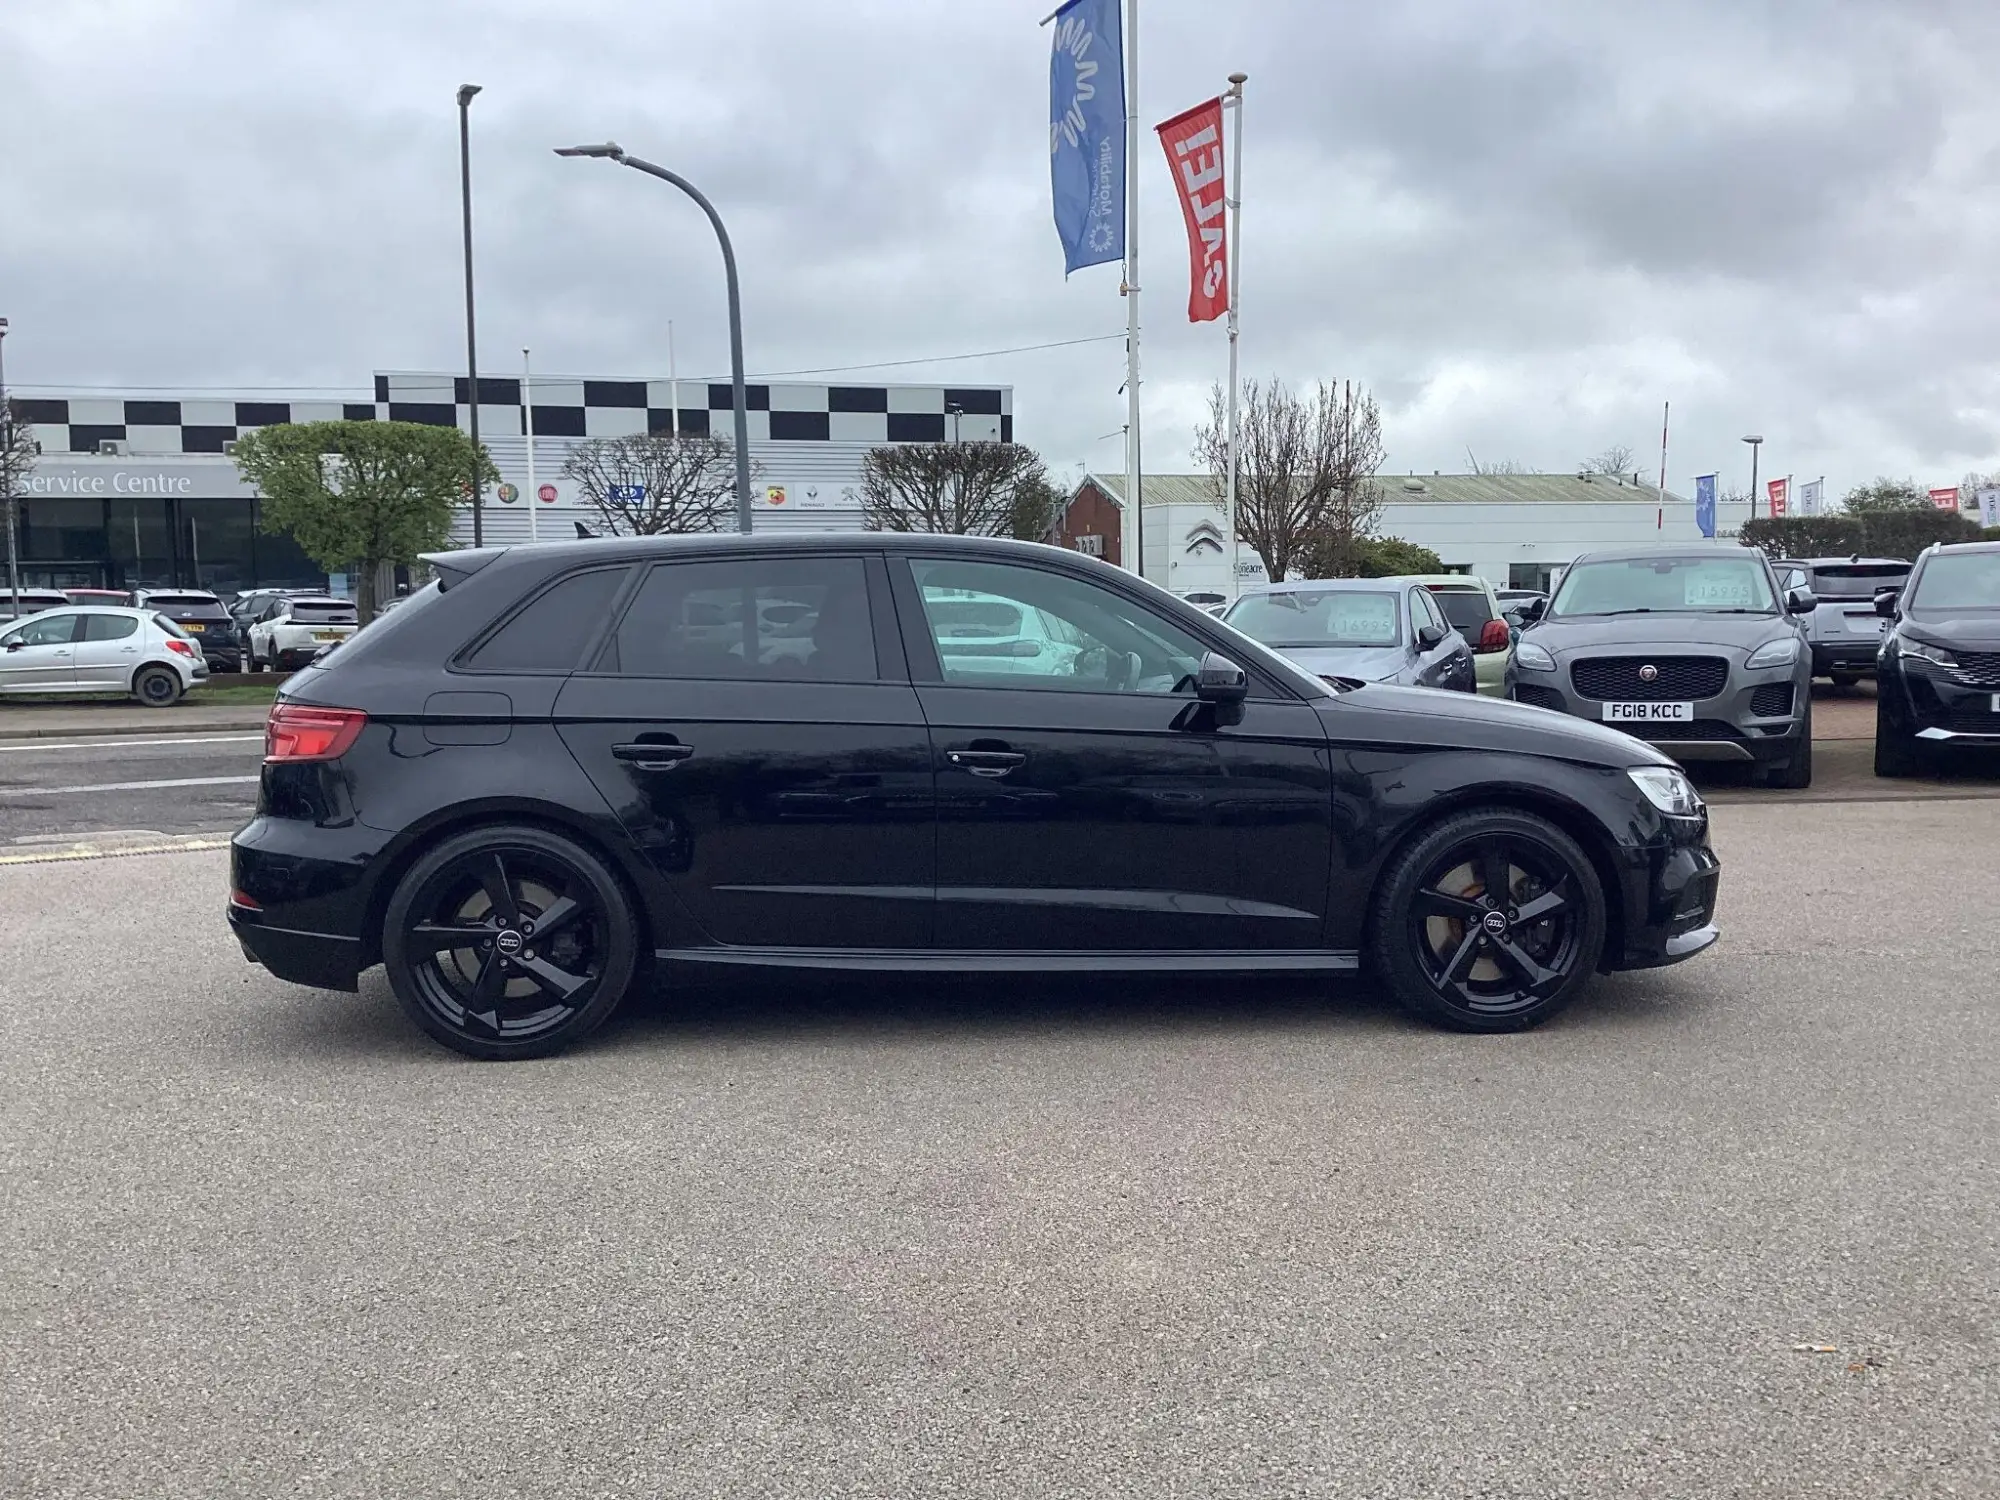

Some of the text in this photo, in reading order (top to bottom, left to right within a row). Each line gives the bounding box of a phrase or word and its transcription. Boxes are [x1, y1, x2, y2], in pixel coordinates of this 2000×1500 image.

[18, 470, 191, 493] Service Centre
[1612, 704, 1682, 718] FG18 KCC
